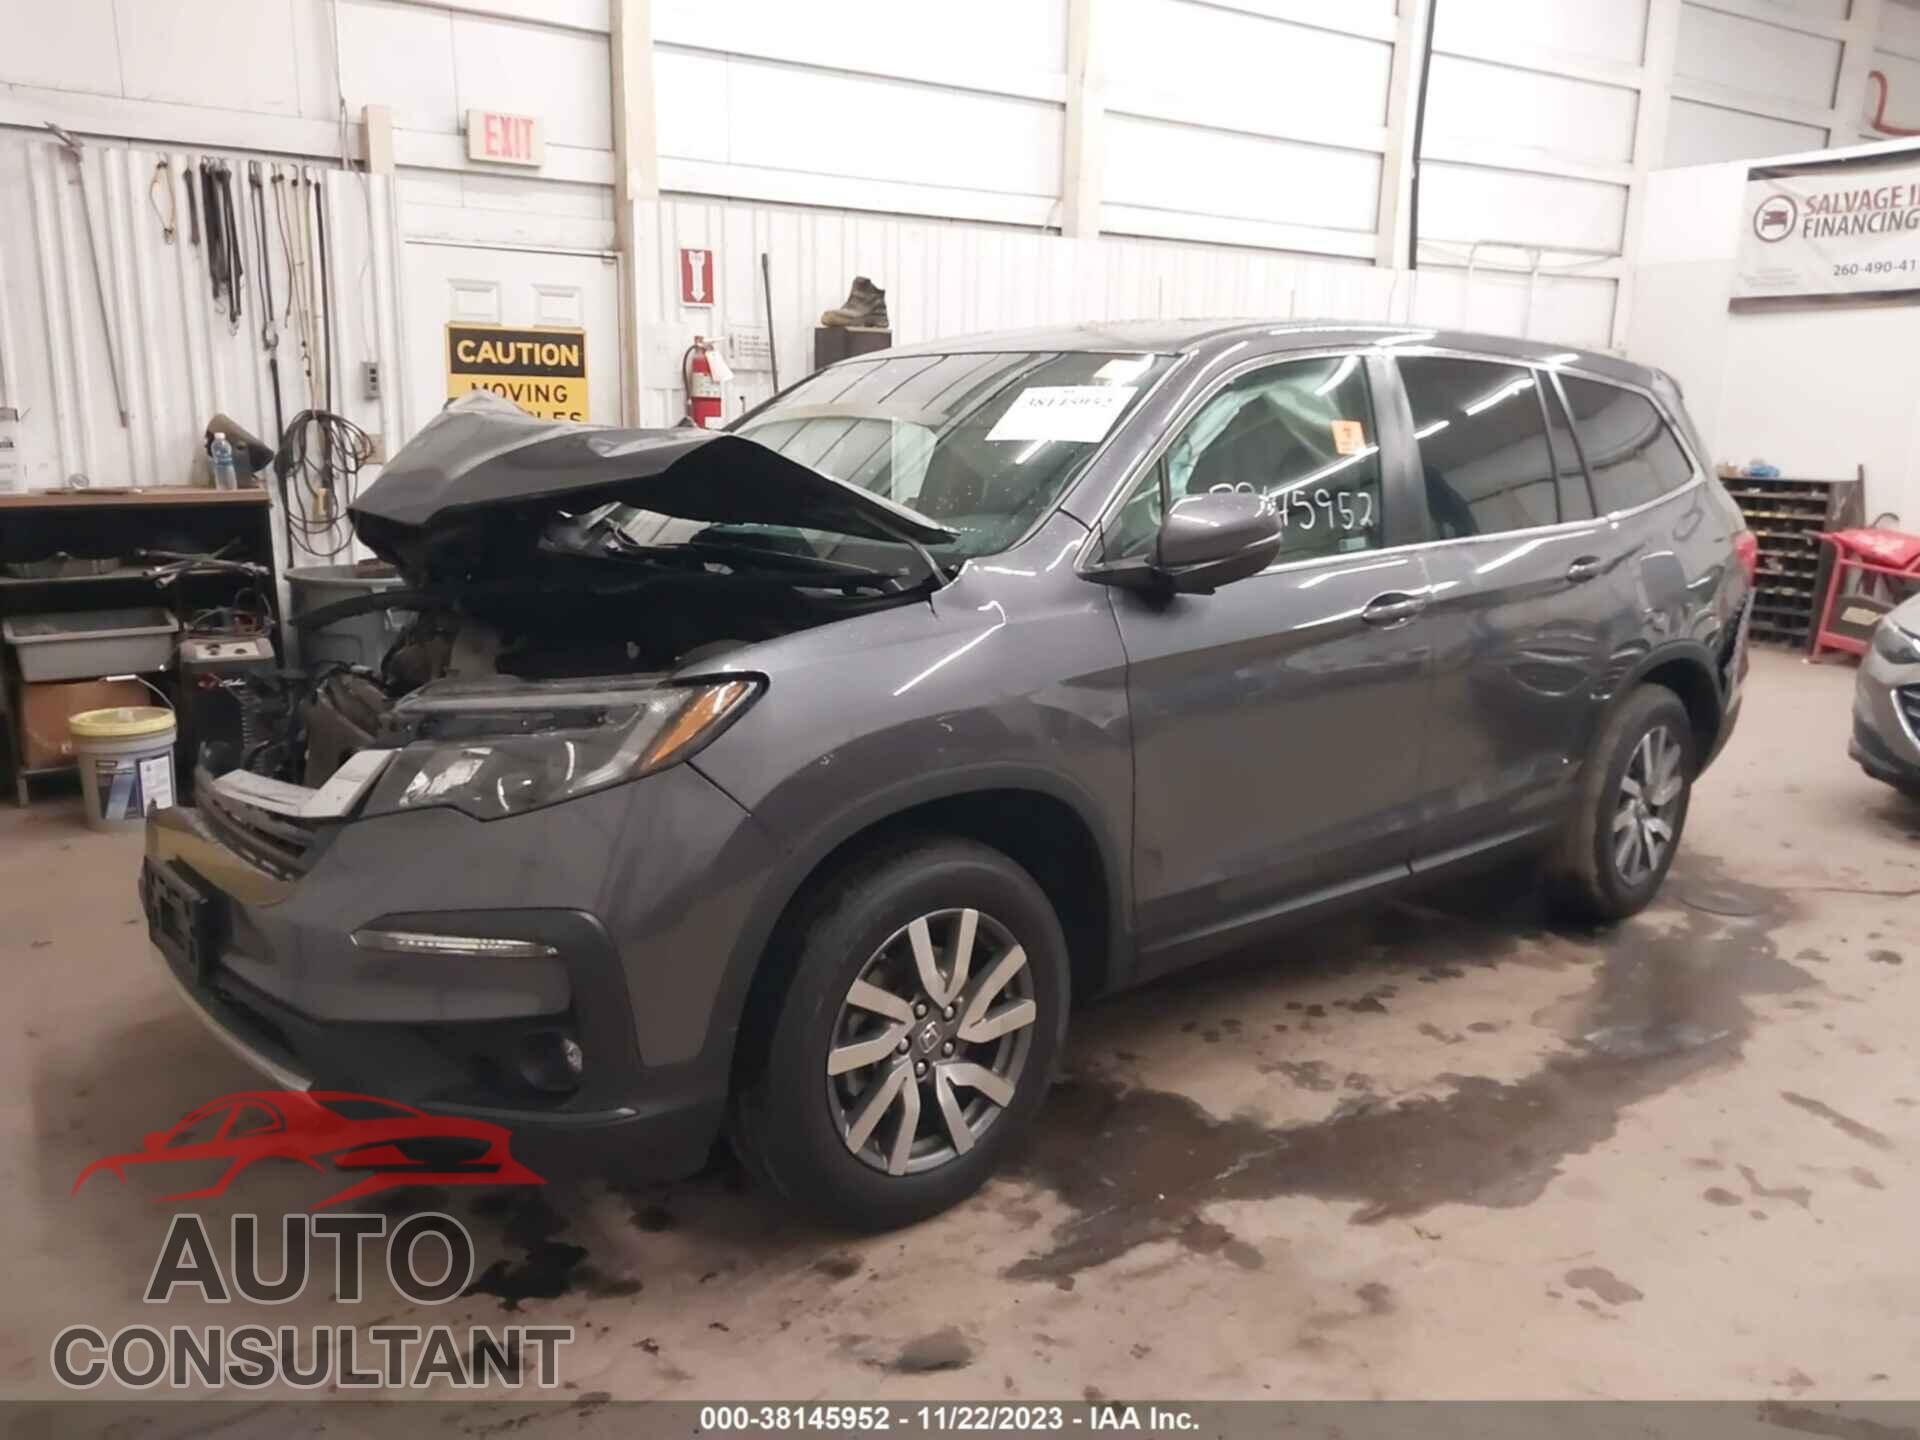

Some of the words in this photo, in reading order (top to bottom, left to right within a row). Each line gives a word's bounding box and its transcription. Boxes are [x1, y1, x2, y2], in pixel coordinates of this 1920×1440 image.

[483, 113, 534, 160] EXIT
[1803, 184, 1903, 217] SALVAGE
[1802, 208, 1920, 239] FINANCING
[456, 339, 580, 367] CAUTION
